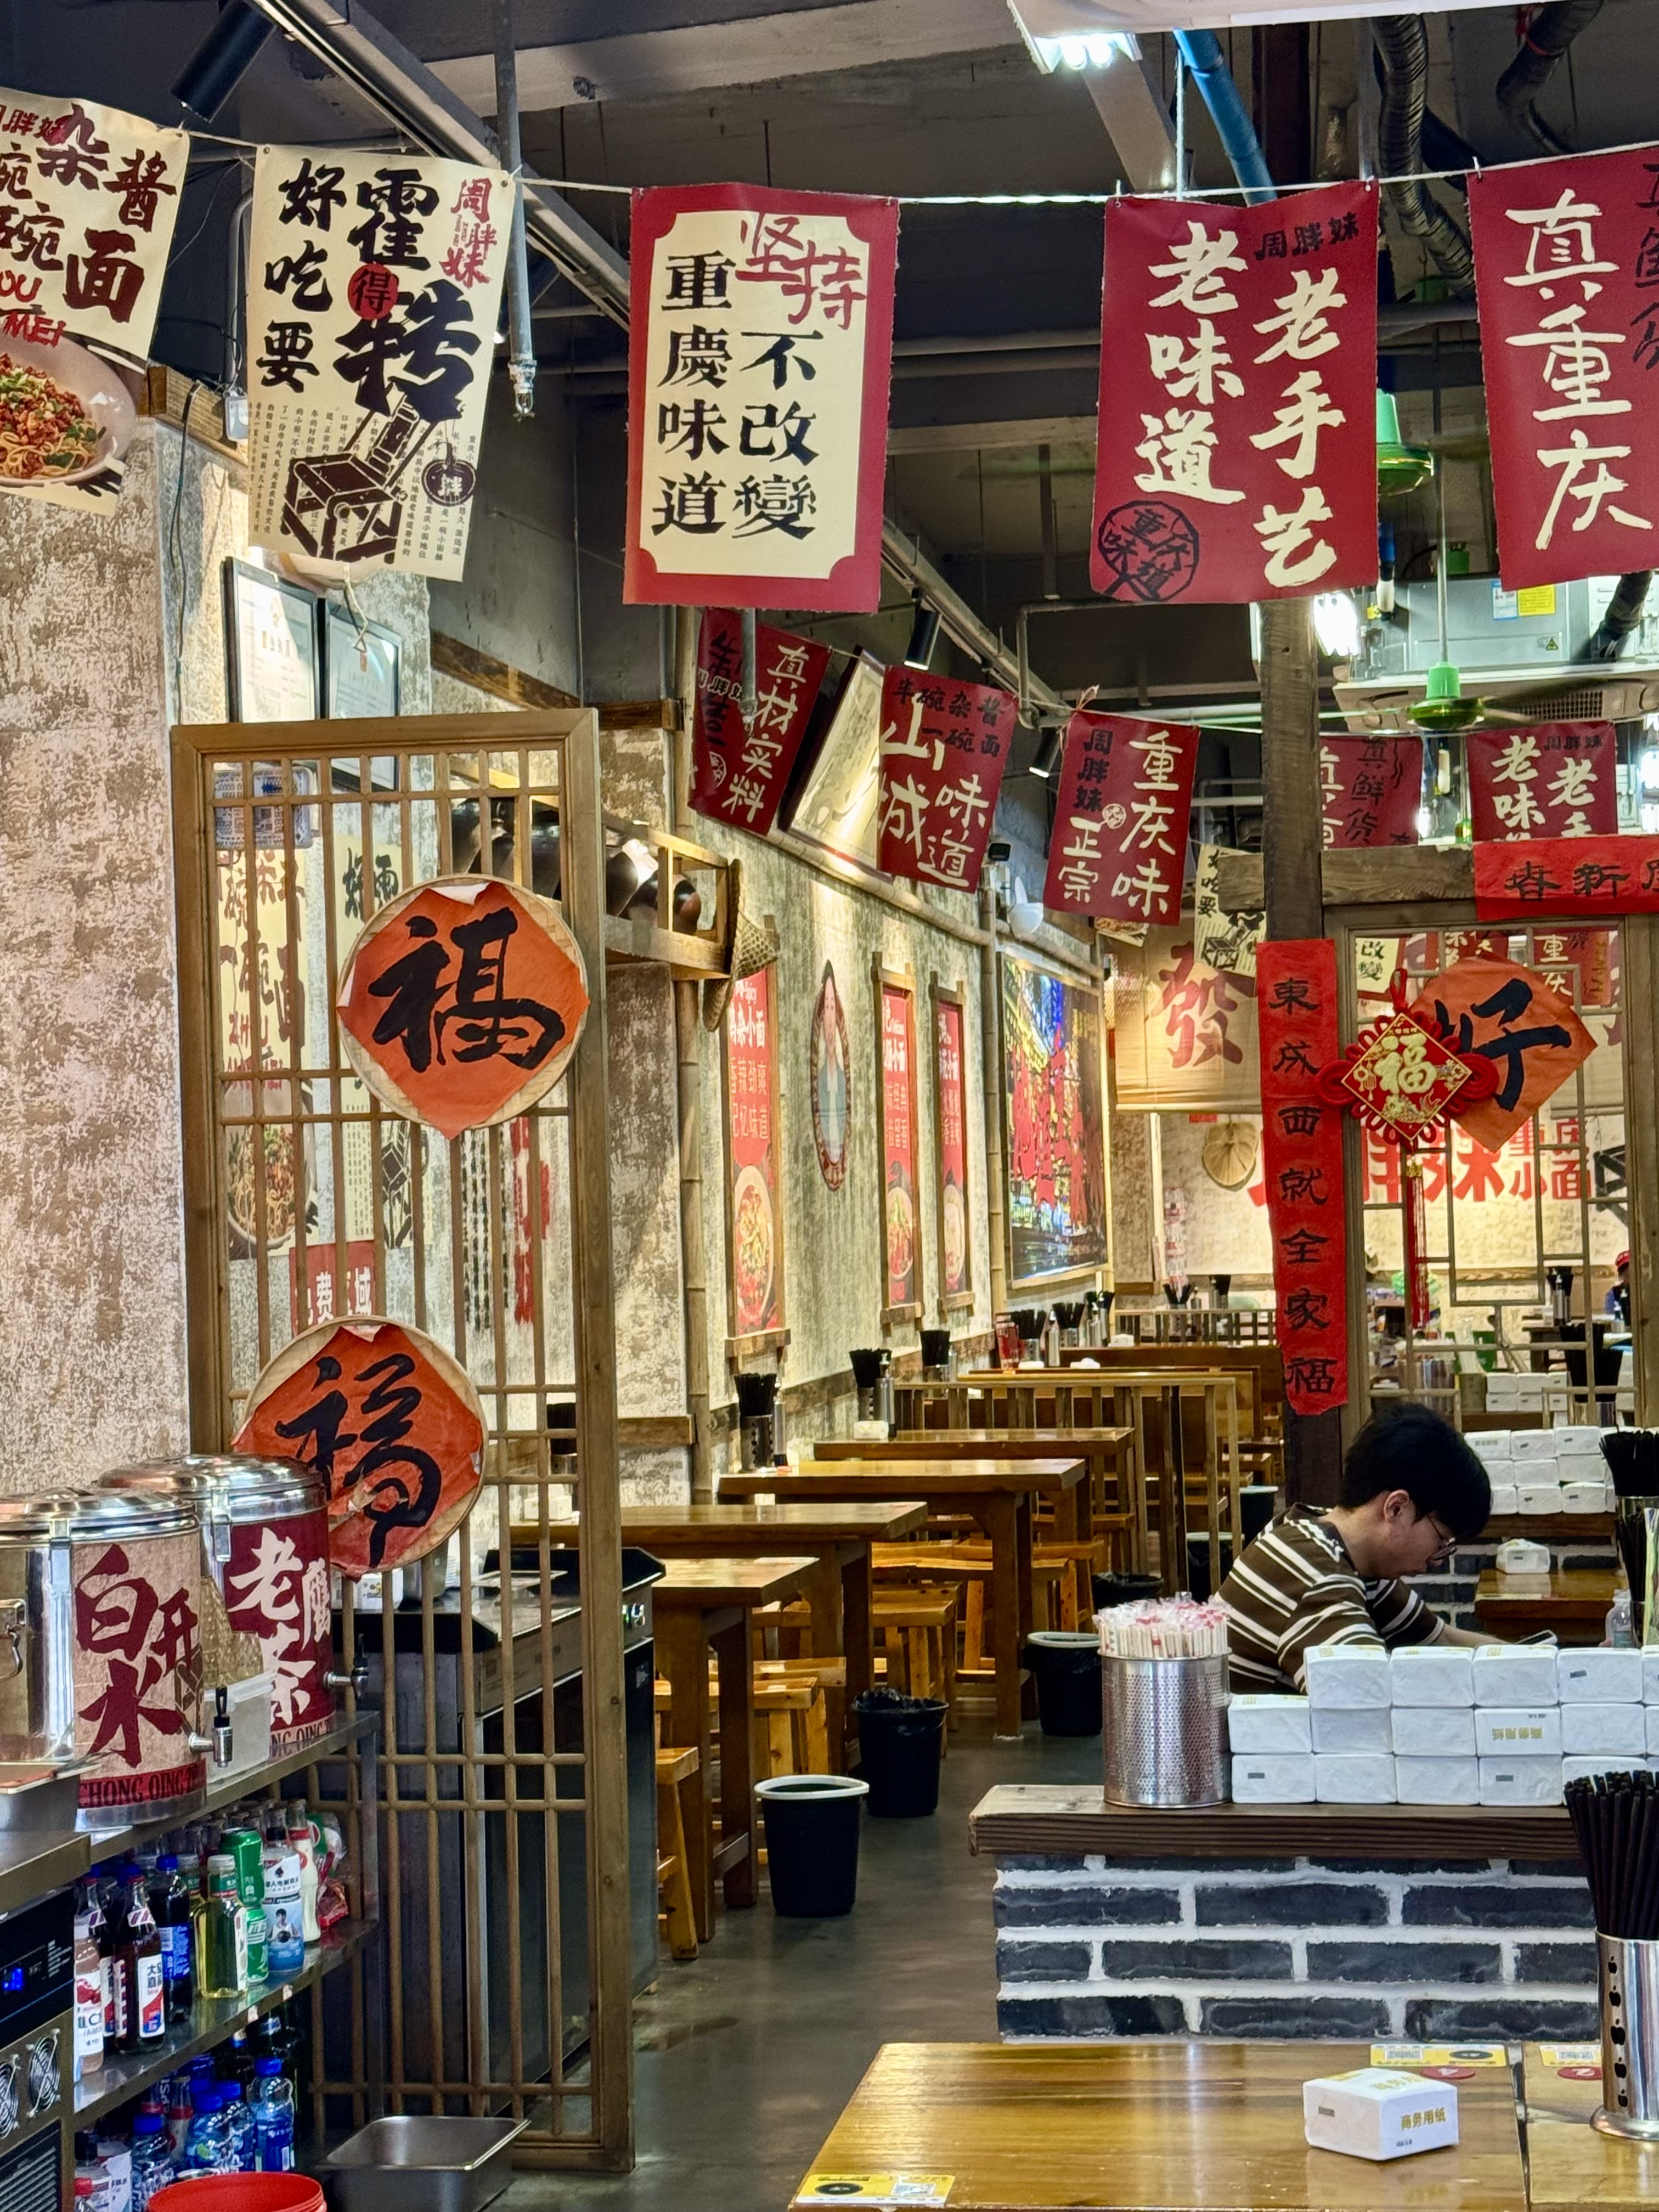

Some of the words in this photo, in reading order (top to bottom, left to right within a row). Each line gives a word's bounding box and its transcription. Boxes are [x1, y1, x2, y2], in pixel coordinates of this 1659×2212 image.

[0, 104, 72, 146] 胖妹
[256, 158, 347, 394] 好吃要
[439, 177, 498, 290] 周胖妹
[736, 212, 867, 330] 坚持
[1254, 212, 1361, 261] 周胖妹
[651, 250, 736, 538] 重慶味道
[1134, 221, 1248, 504] 老味道
[1502, 187, 1654, 550] 真重庆
[732, 330, 825, 540] 不改變
[1249, 267, 1348, 589] 老手艺
[721, 644, 810, 823] 真材实料
[1073, 729, 1114, 812] 周胖妹
[1491, 735, 1547, 842] 老味
[1058, 816, 1103, 904] 正宗
[1373, 1032, 1437, 1094] 福
[1268, 978, 1335, 1397] 東成西就全家福
[1401, 2106, 1447, 2131] 商务用纸
